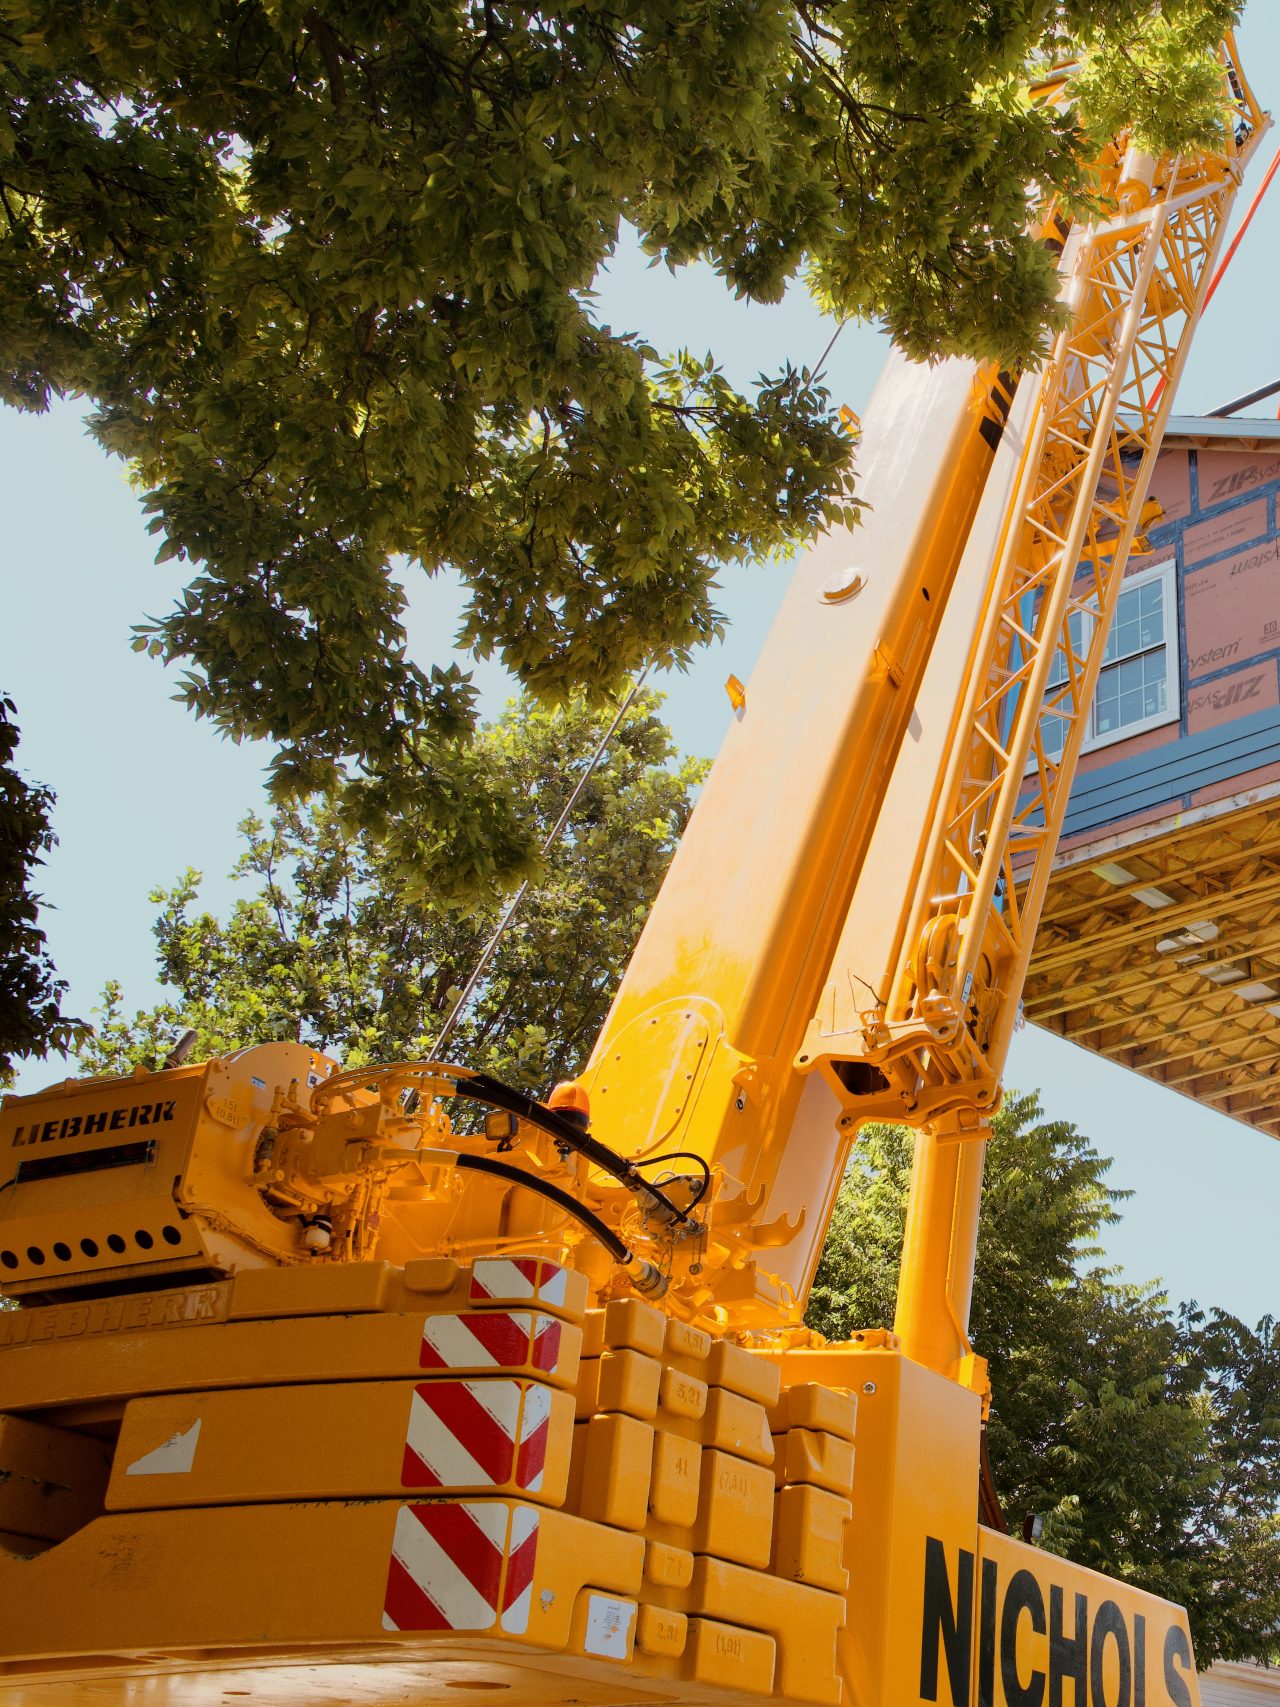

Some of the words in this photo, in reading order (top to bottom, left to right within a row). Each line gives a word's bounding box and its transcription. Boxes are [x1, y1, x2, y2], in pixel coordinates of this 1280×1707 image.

[1188, 640, 1240, 671] ystem
[11, 1100, 177, 1147] LIEBHERR
[920, 1535, 1192, 1707] NICHOLS
